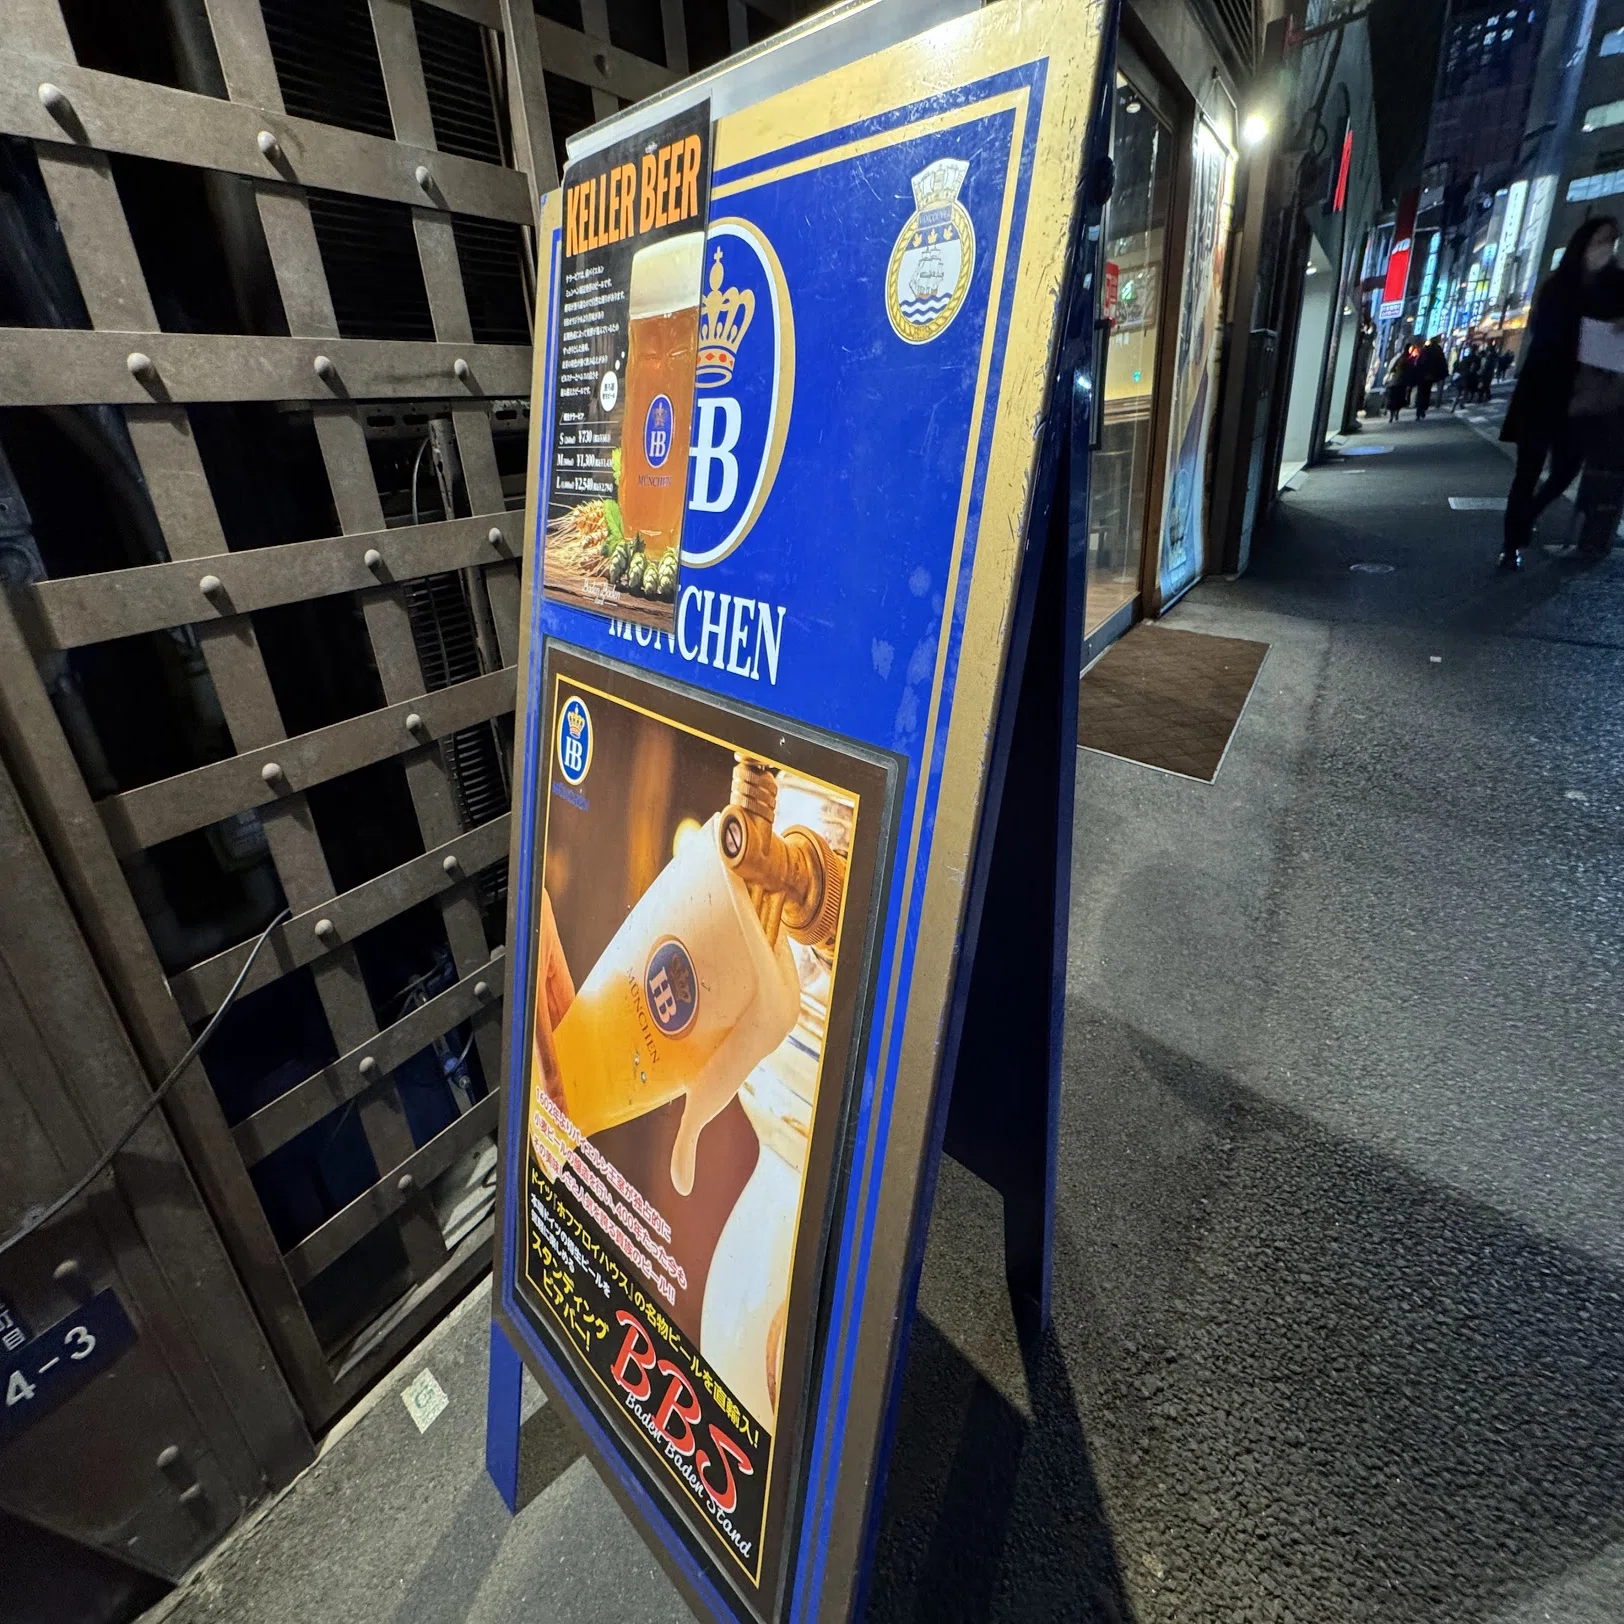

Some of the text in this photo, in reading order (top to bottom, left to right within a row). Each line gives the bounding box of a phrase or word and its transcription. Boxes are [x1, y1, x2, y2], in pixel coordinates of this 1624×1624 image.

[566, 134, 701, 257] KELLER BEER
[608, 585, 787, 686] CHEN
[565, 736, 583, 772] HB
[649, 966, 678, 1024] HB
[532, 1231, 610, 1339] スタンディング
[5, 1326, 96, 1407] 4-3
[610, 1309, 754, 1513] BBS
[625, 1391, 751, 1559] Baden Baden Stand
